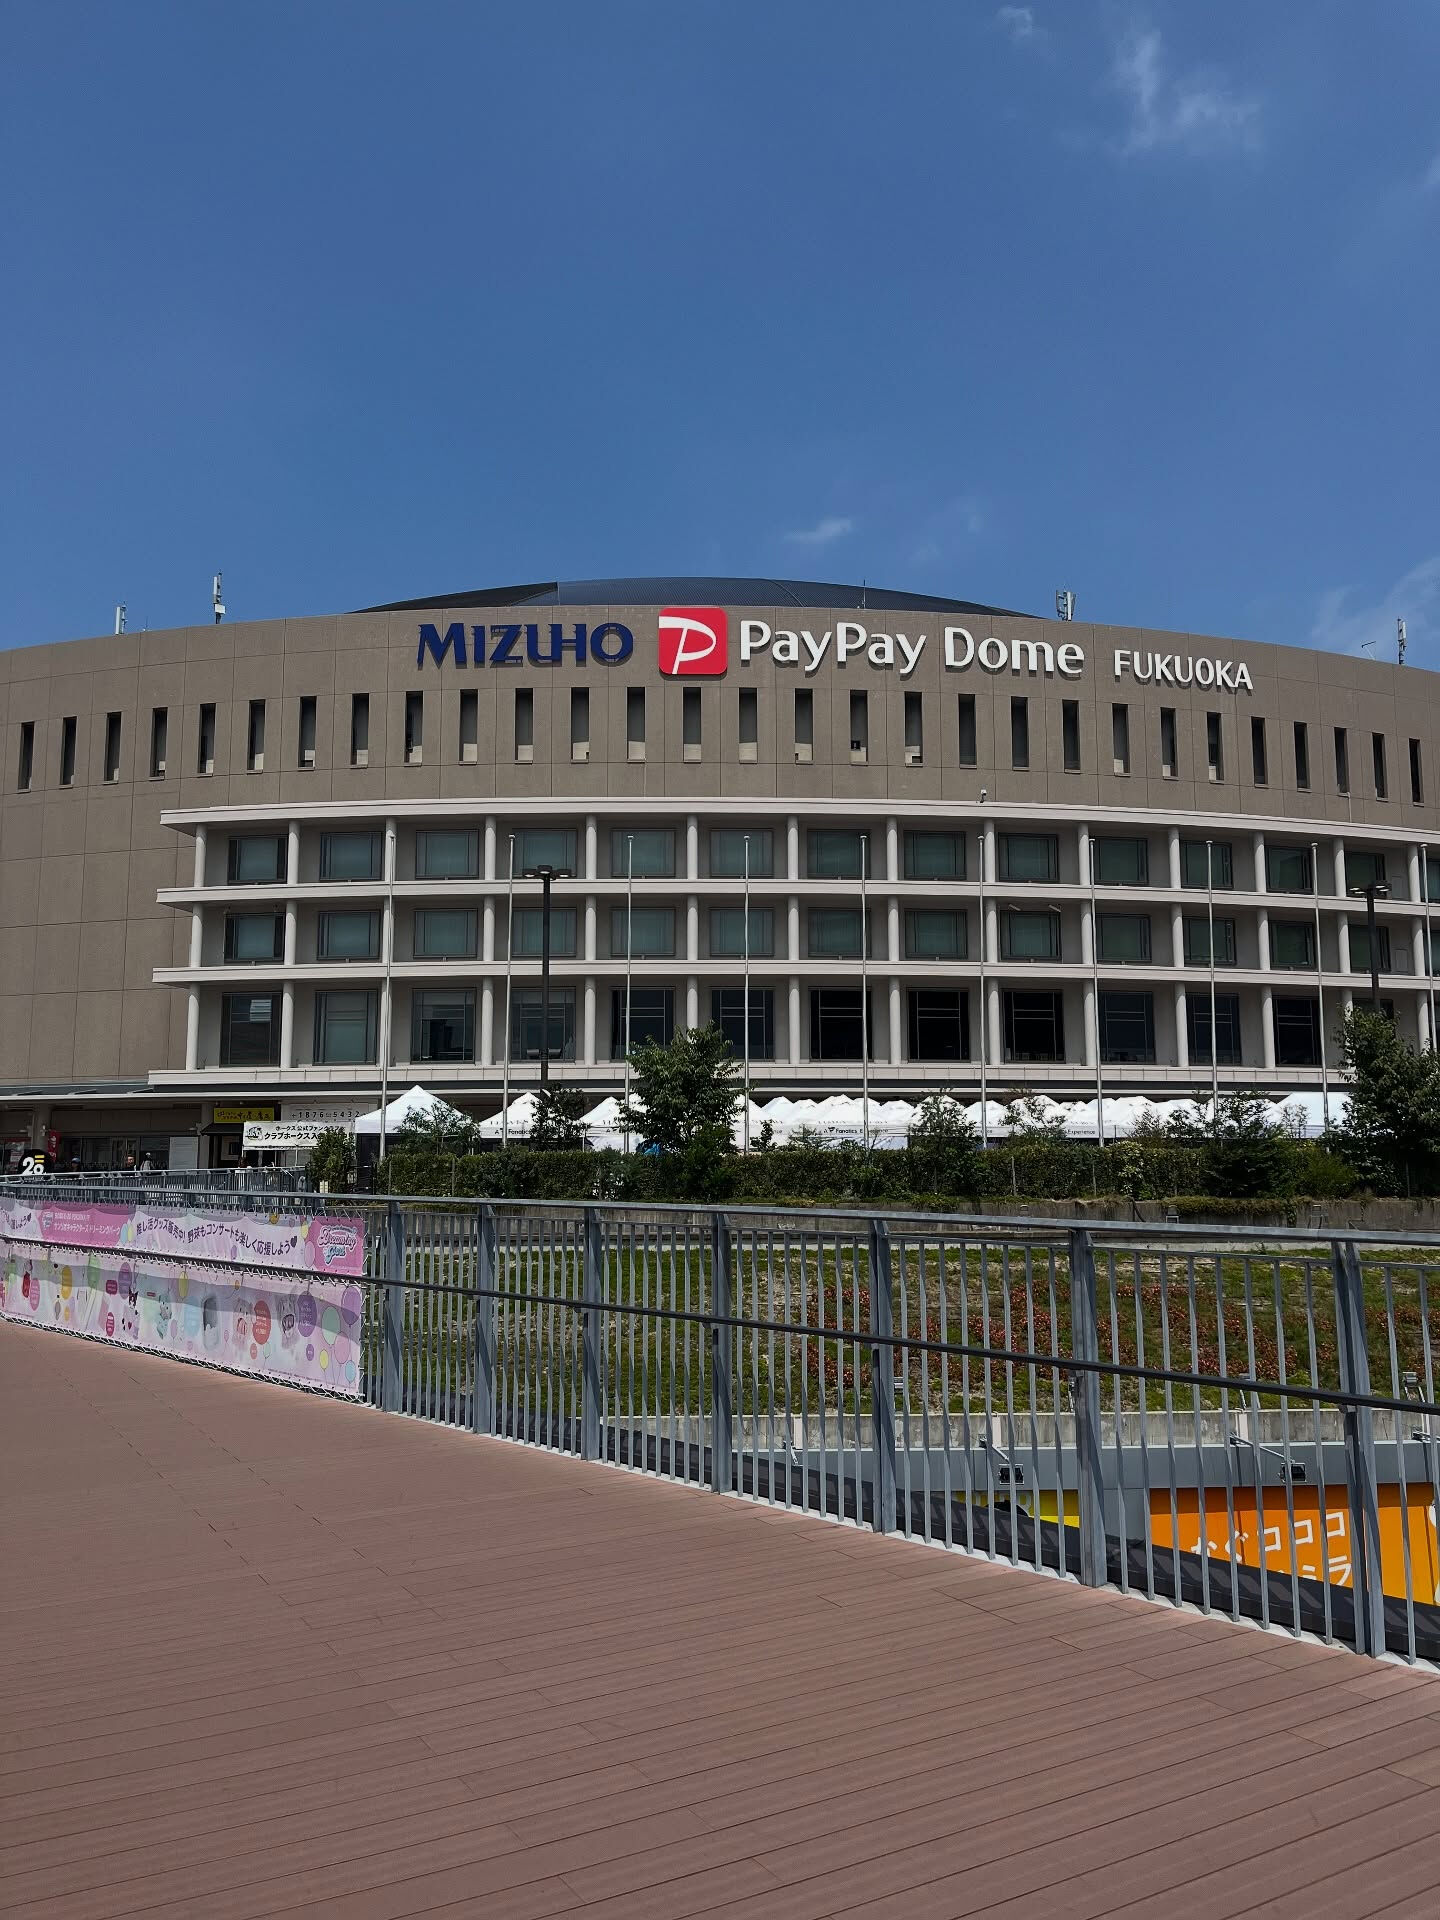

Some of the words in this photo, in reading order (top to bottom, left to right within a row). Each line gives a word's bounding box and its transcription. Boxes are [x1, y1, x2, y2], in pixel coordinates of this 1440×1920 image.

[417, 622, 634, 666] MIZUHO
[739, 620, 927, 674] PayPay
[944, 626, 1085, 675] Dome
[1113, 649, 1254, 690] FUKUOKA
